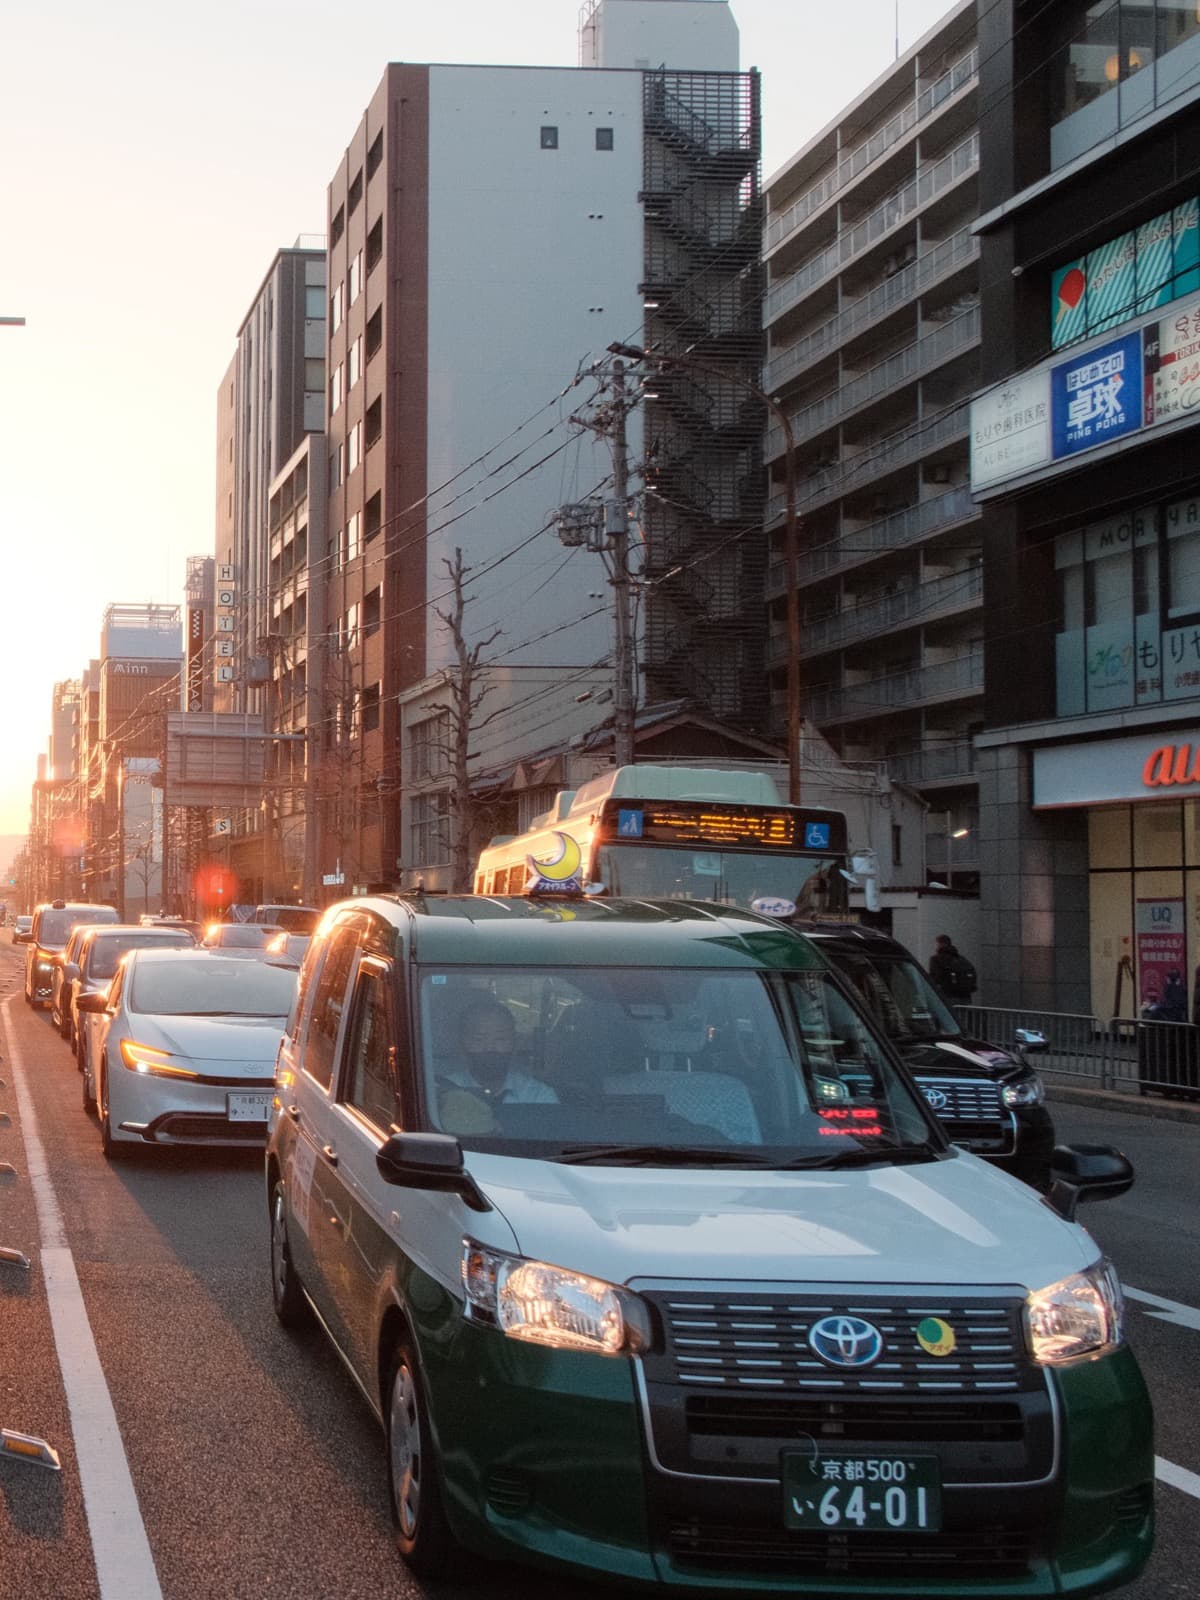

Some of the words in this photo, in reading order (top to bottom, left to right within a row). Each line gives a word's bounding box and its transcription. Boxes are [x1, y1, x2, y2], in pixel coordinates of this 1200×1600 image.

[1069, 355, 1122, 387] はじめての
[1067, 374, 1124, 429] 卓球
[975, 402, 1047, 443] もりや歯科医院
[1067, 427, 1091, 443] PING
[1096, 412, 1125, 430] PONG
[221, 567, 231, 681] HOTEL
[113, 663, 148, 675] Minn
[1151, 907, 1172, 922] UQ
